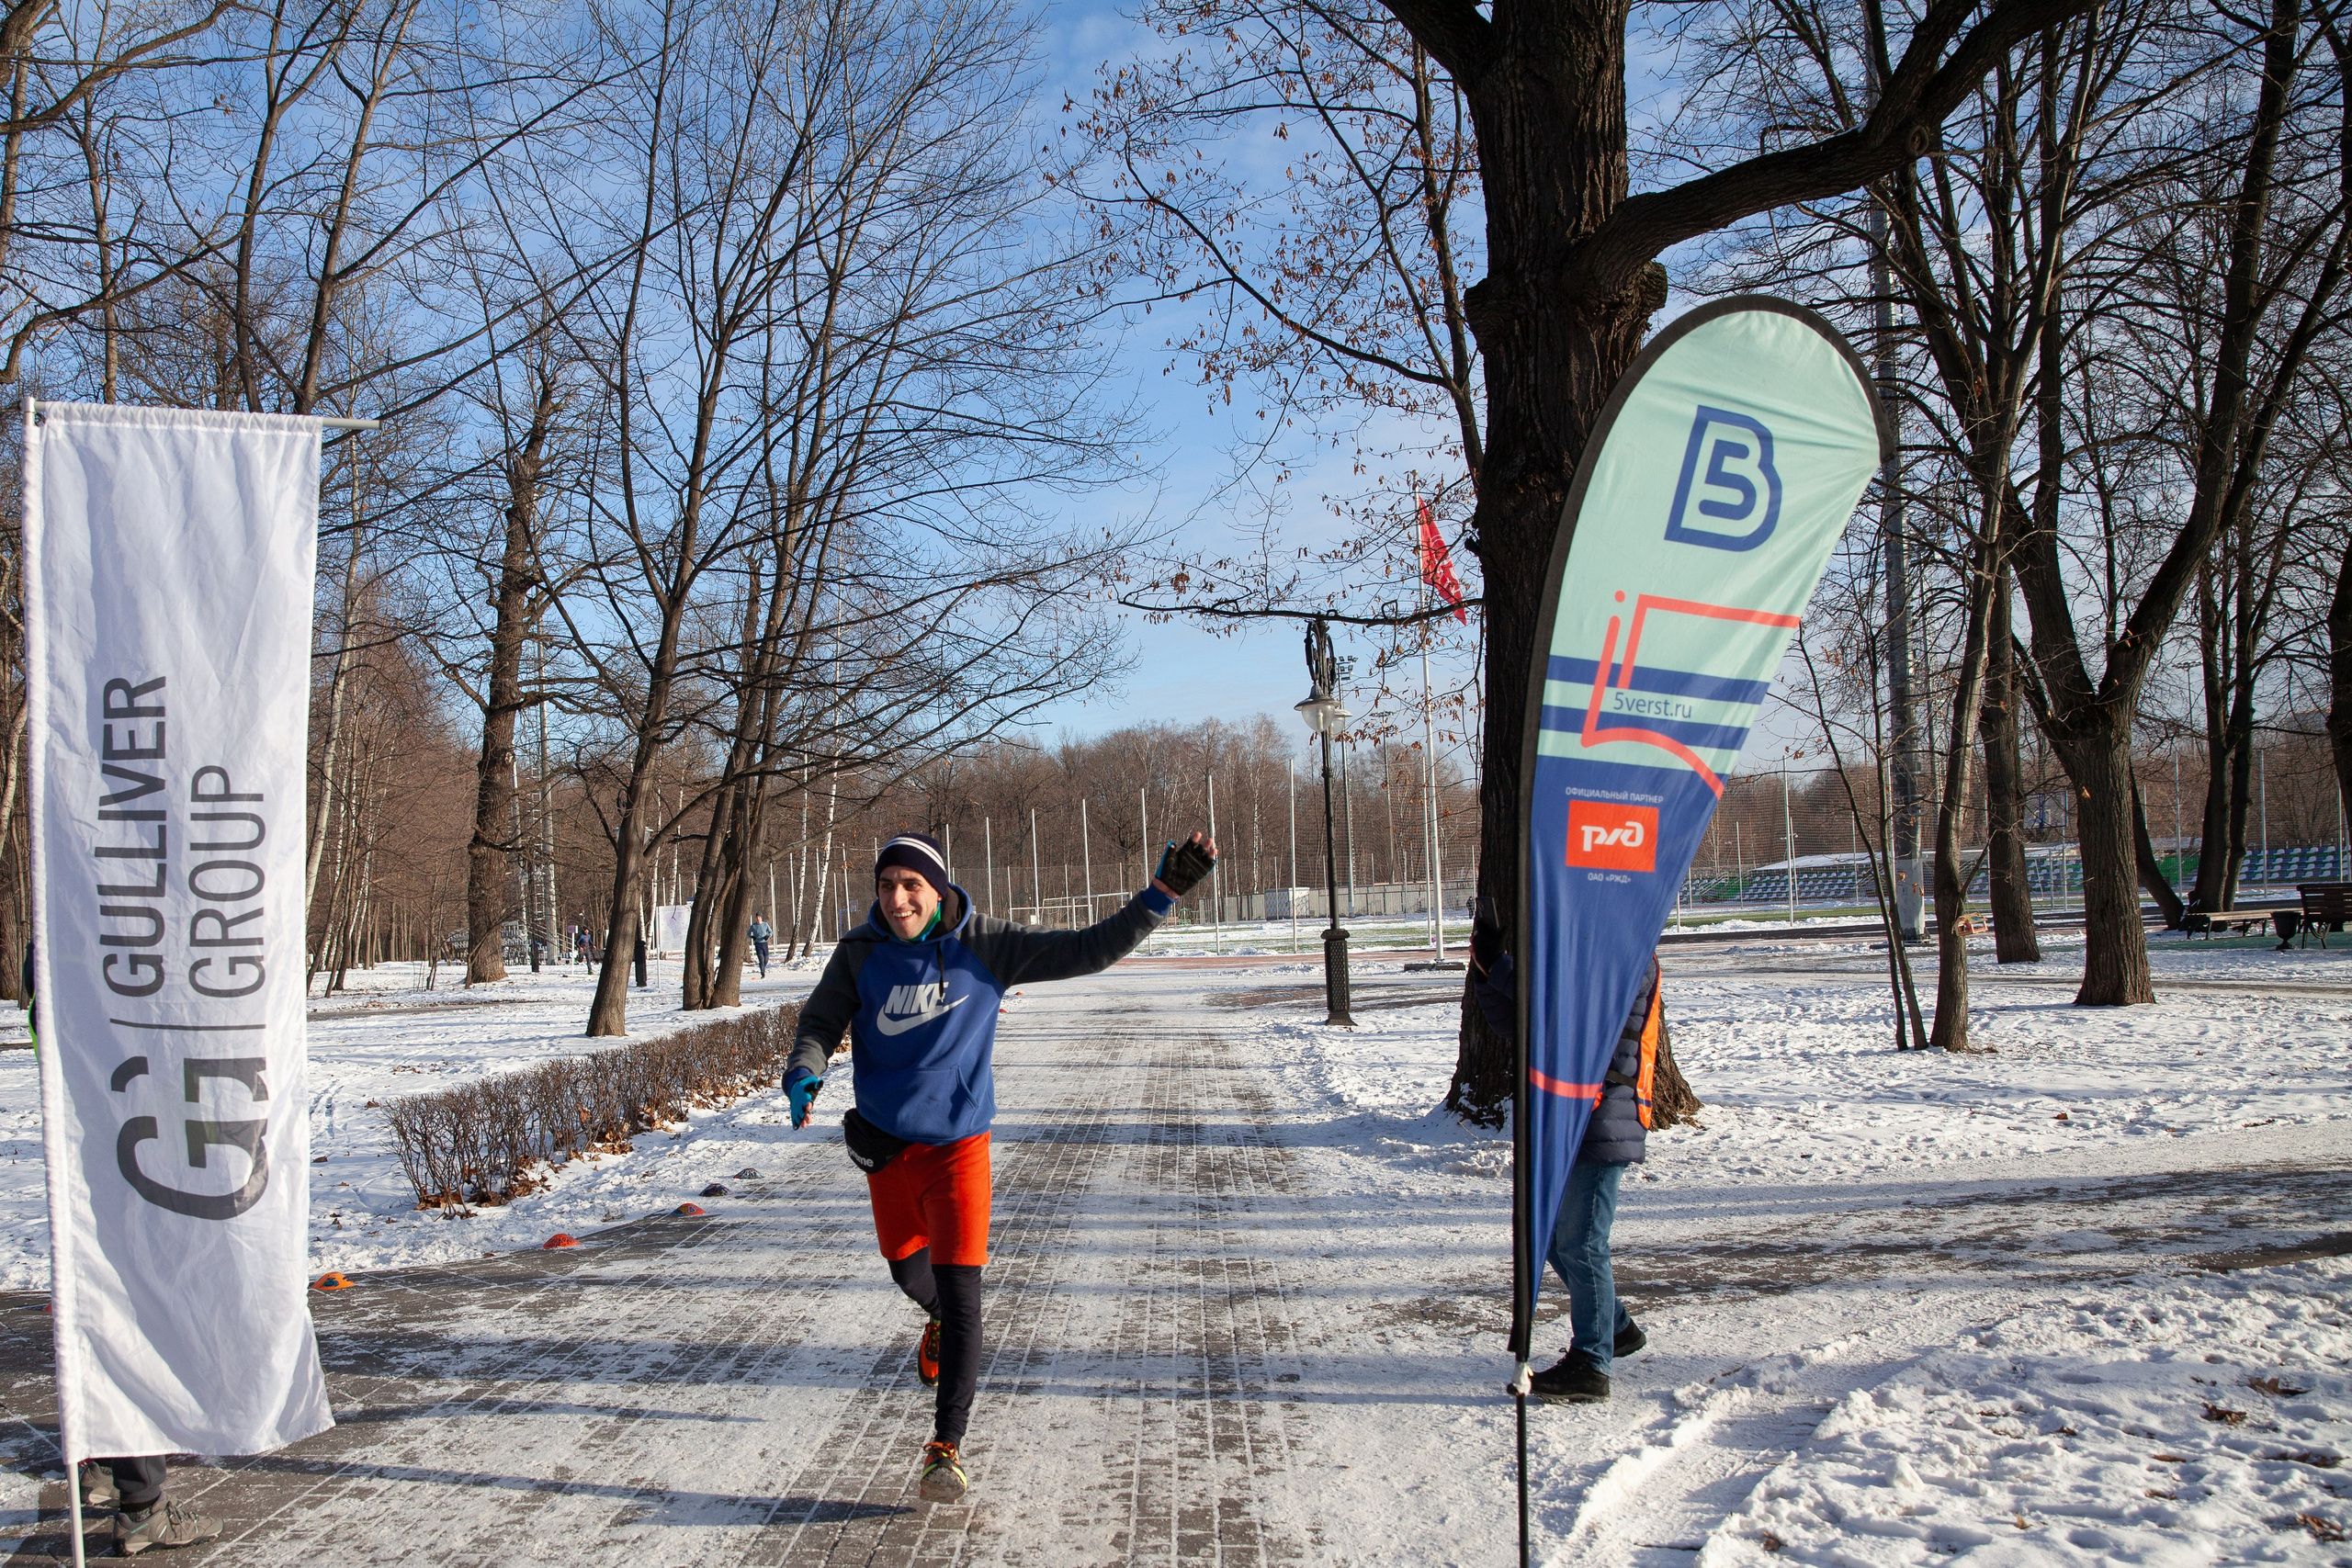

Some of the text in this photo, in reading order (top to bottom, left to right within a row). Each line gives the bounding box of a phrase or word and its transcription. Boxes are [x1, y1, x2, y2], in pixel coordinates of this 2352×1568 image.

[1613, 692, 1692, 718] 5verst.ru
[1565, 786, 1664, 804] ОФИЦИАЛЬНЫЙ ПАРТНЕР
[95, 676, 166, 998] GULLIVER
[187, 764, 266, 998] GROUP
[1588, 872, 1632, 884] ОАО «РЖД»
[885, 982, 949, 1014] NIKE
